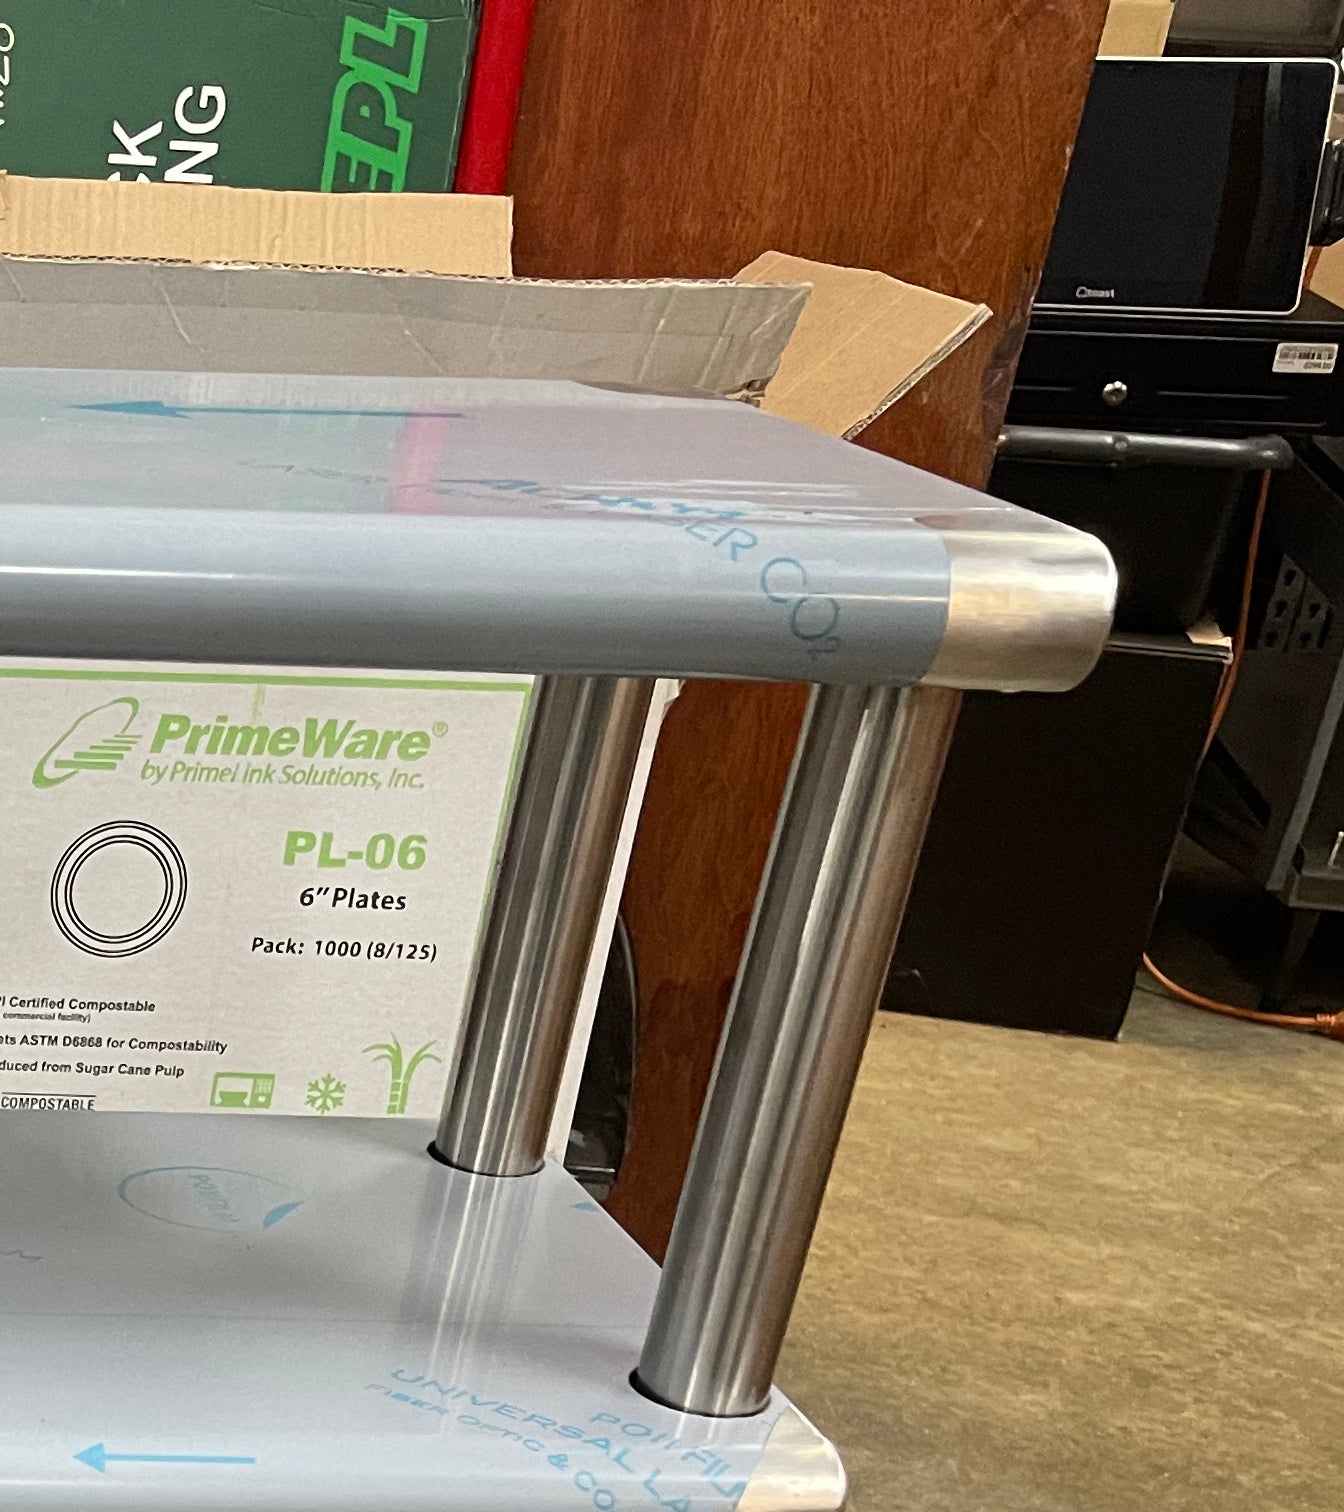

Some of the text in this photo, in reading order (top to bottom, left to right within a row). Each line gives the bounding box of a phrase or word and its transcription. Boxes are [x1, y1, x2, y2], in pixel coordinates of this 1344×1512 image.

[140, 759, 169, 786] by
[242, 764, 276, 785] Ink
[281, 764, 382, 790] Solutions,
[386, 767, 426, 789] Inc.
[282, 830, 429, 871] PL-06
[330, 887, 408, 911] Plates
[250, 936, 438, 964] Pack: 1000 (8/125)
[9, 995, 65, 1010] Certified
[68, 998, 156, 1013] Compostable
[19, 1034, 59, 1047] ASTM
[106, 1036, 126, 1049] for
[128, 1037, 228, 1055] Compostability
[41, 1060, 72, 1073] from
[75, 1062, 115, 1077] Sugar
[117, 1063, 152, 1076] Cane
[154, 1064, 185, 1079] Pulp
[391, 1368, 636, 1474] UNIVERSAL
